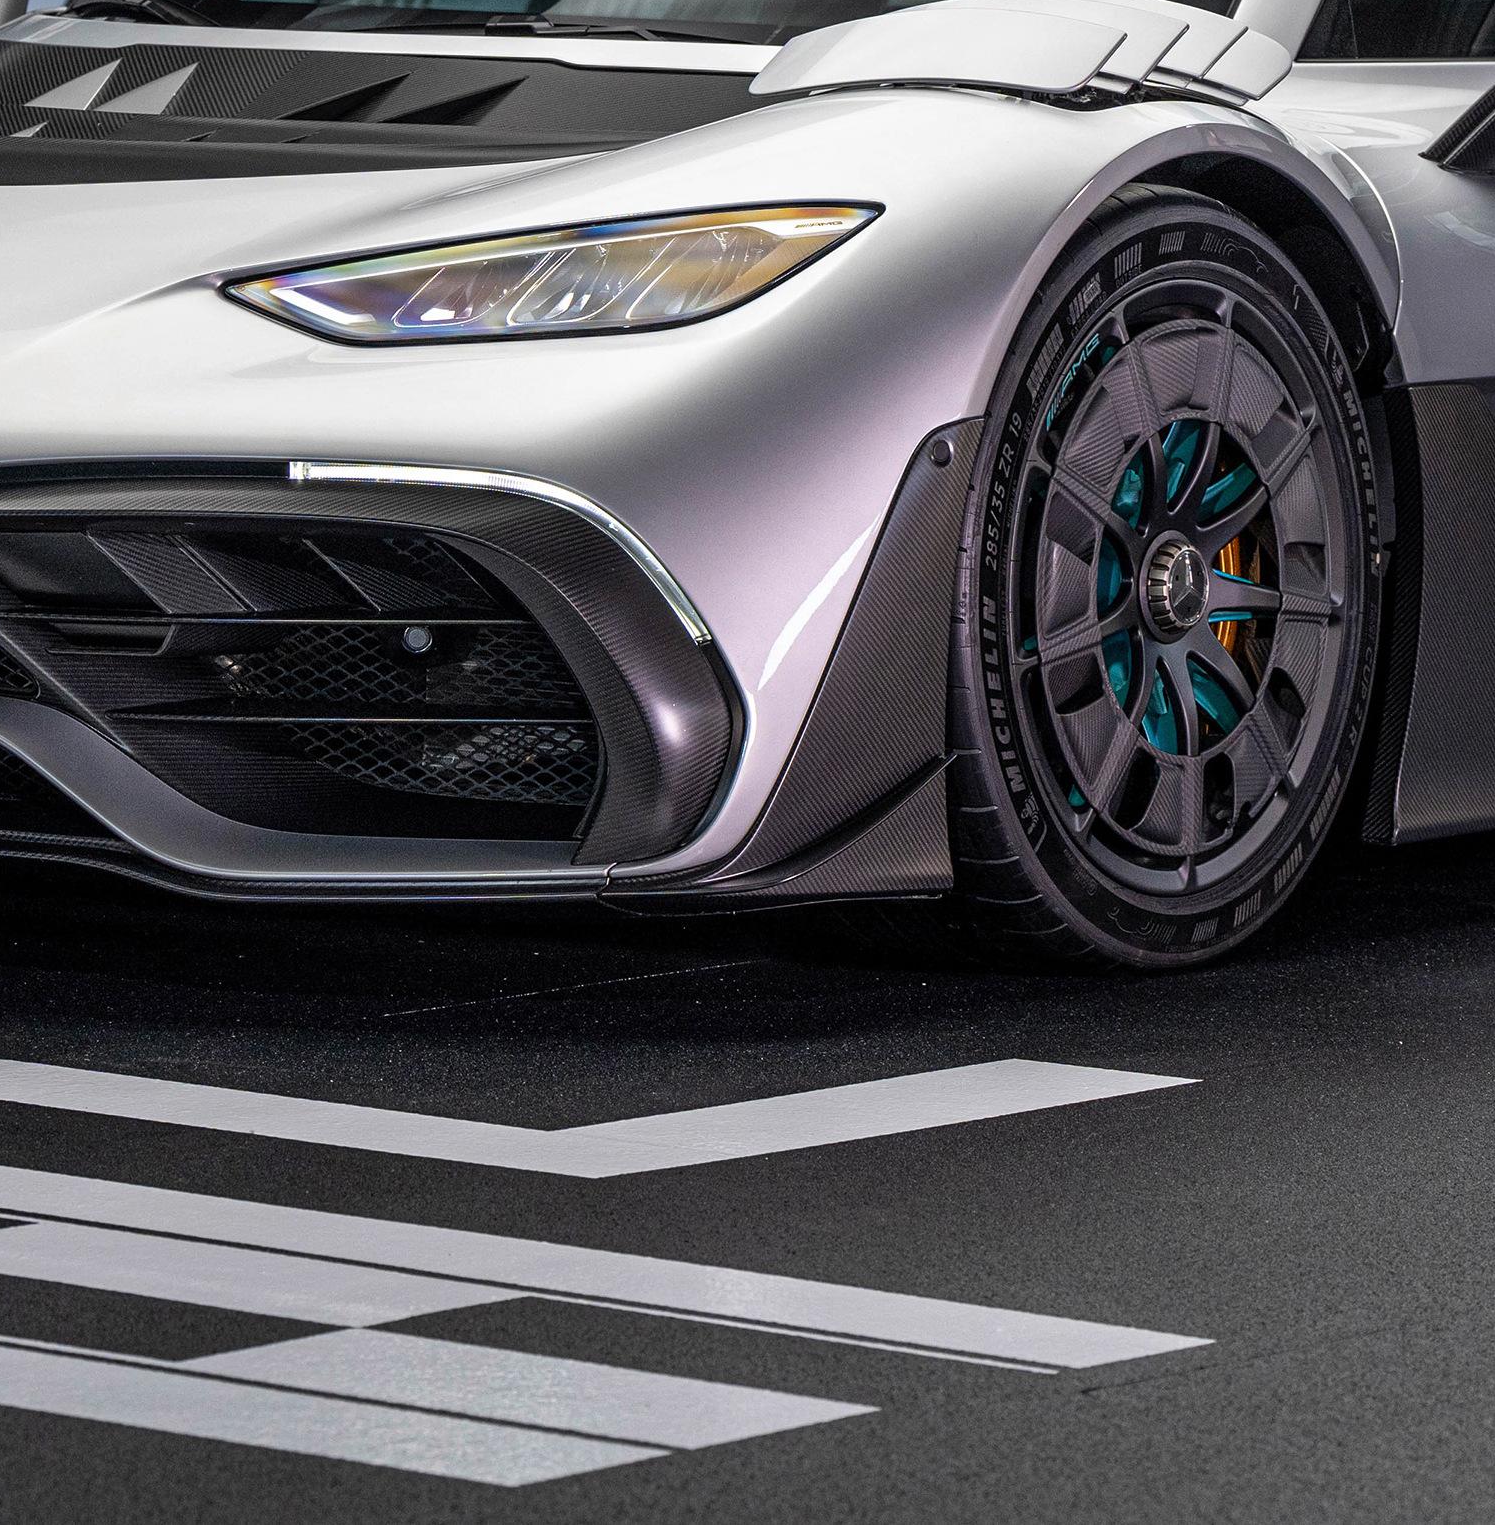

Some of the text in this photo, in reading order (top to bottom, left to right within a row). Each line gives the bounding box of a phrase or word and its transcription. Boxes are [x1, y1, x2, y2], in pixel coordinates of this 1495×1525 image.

[983, 411, 1026, 794] MICHELIN 285/35 ZR 19
[1343, 389, 1380, 578] MICHELIN
